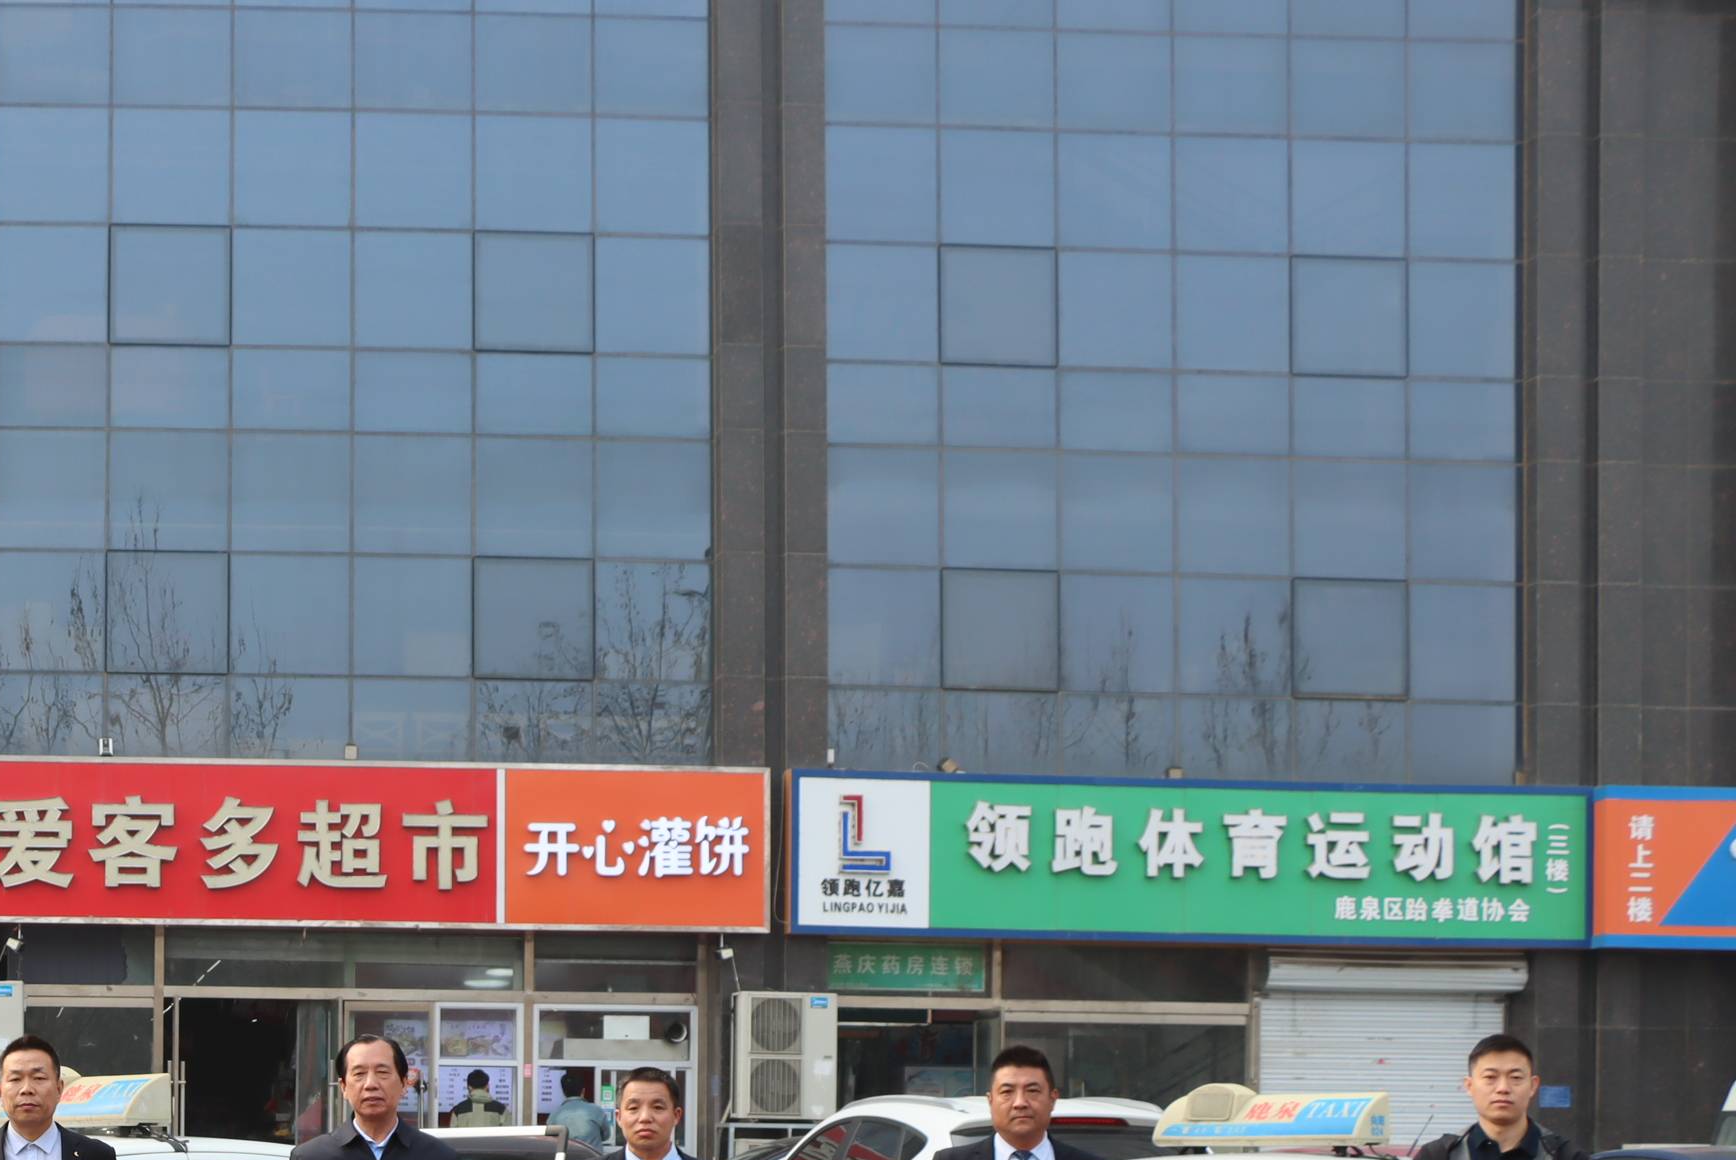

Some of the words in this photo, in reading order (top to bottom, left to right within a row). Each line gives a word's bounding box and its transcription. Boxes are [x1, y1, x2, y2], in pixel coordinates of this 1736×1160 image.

[524, 816, 750, 878] 开心灌饼
[966, 800, 1539, 884] 领跑体育运动馆
[1627, 814, 1655, 923] 请上二楼
[821, 878, 906, 898] 领跑亿嘉
[822, 901, 875, 914] LINGPAO
[877, 902, 908, 915] YIJIA
[1334, 895, 1531, 923] 鹿泉区跆拳道协会
[833, 953, 974, 977] 燕庆药房连锁
[1244, 1101, 1301, 1121] 鹿泉
[1306, 1100, 1368, 1121] TAXI
